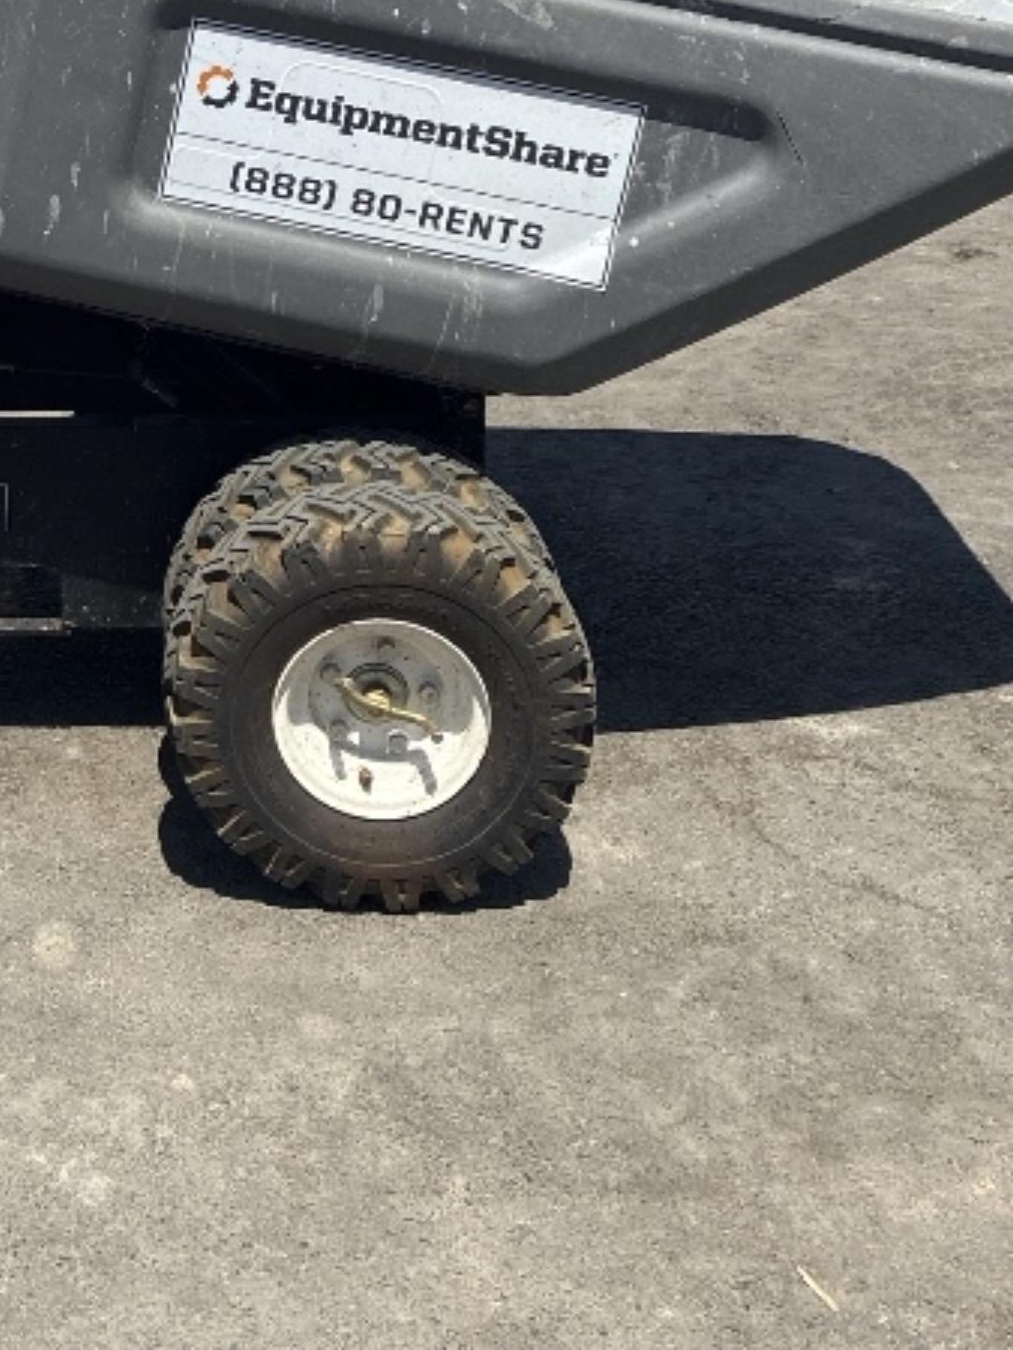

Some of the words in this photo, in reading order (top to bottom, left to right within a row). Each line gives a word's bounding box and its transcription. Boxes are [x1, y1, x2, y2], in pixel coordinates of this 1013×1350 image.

[245, 77, 610, 178] EquipmentShare
[230, 161, 336, 212] (888)
[351, 187, 544, 251] 80-RENTS
